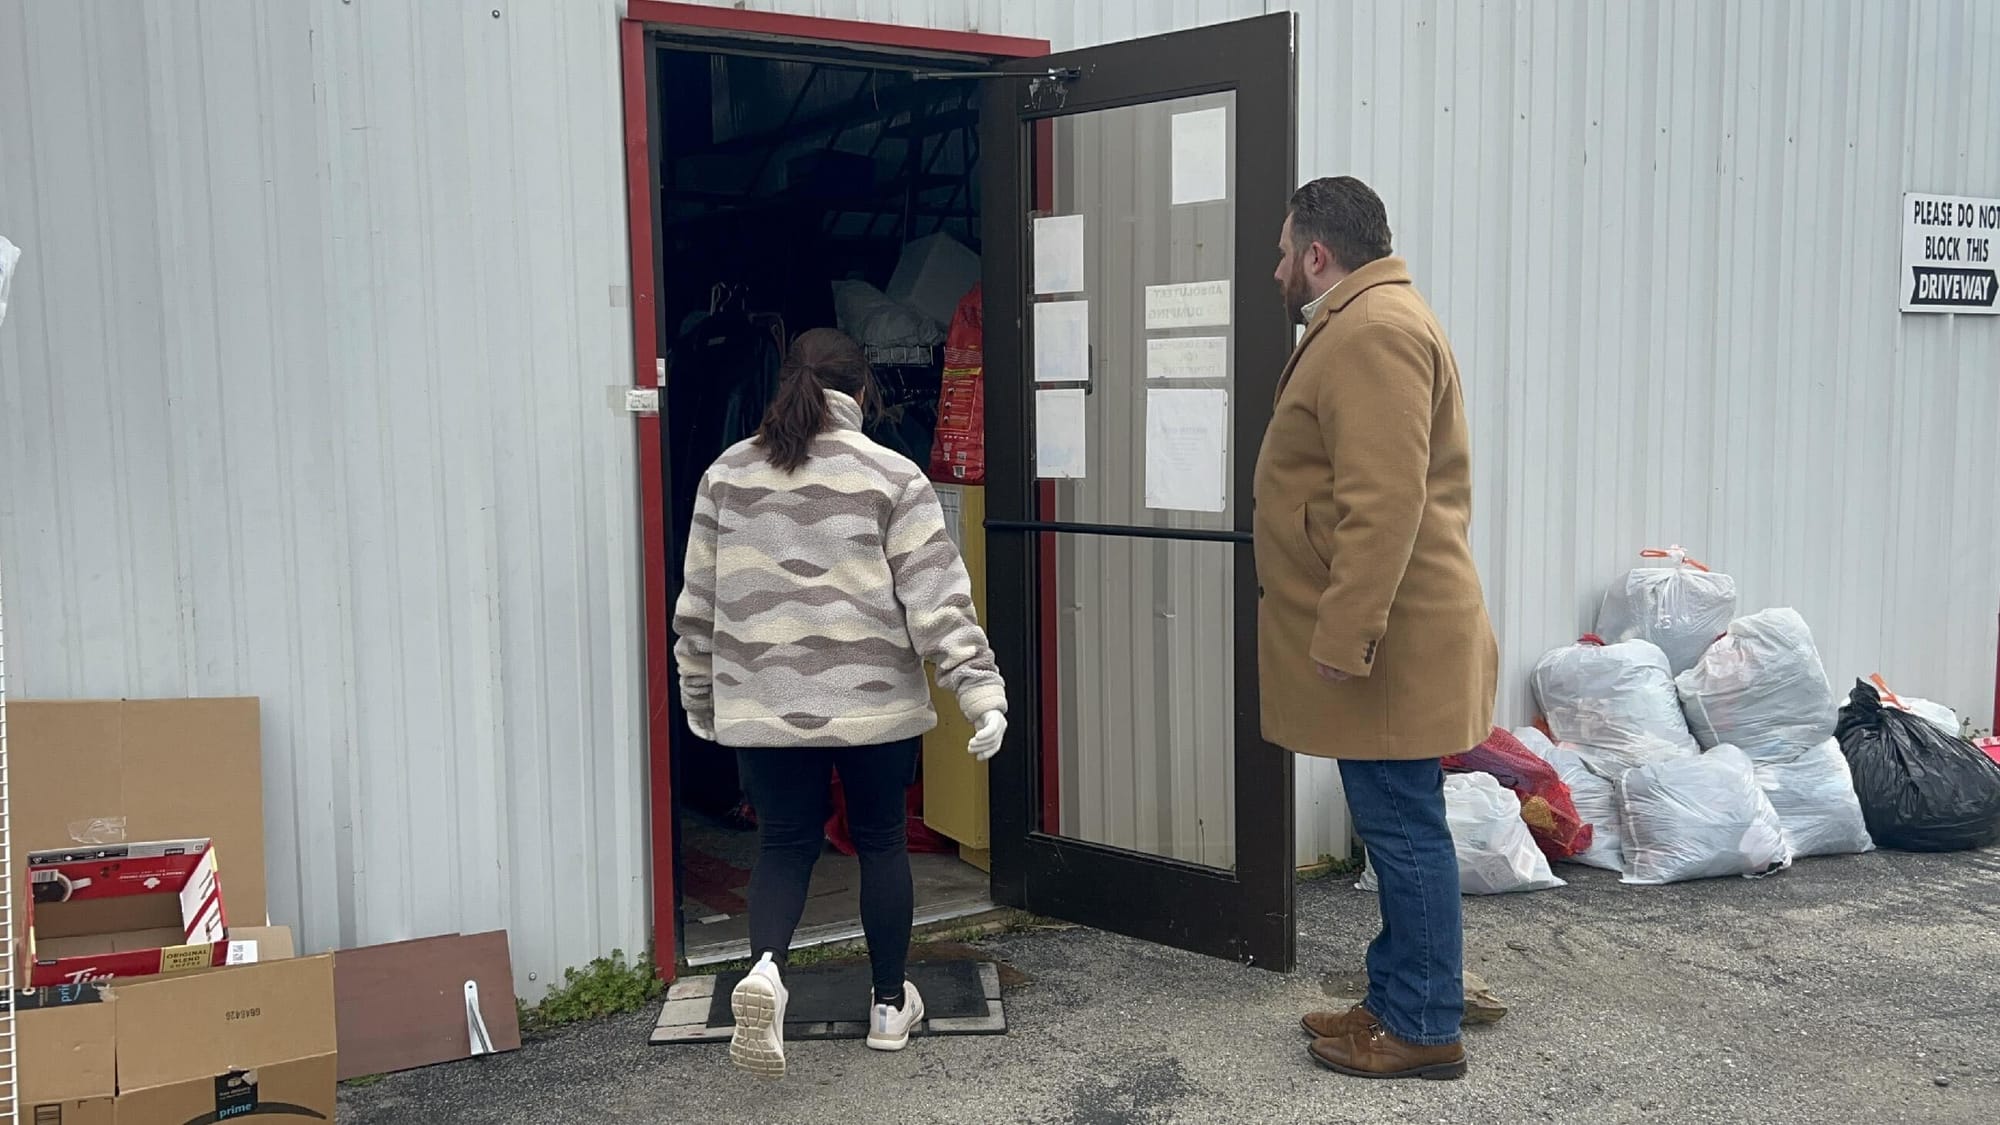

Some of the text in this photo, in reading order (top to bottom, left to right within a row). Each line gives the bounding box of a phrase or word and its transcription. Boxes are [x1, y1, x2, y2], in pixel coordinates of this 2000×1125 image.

[1914, 201, 2000, 229] PLEASE DO NOT
[1925, 236, 1989, 262] BLOCK THIS
[1918, 274, 1991, 300] DRIVEWAY
[167, 949, 207, 959] ORIGINAL
[219, 1103, 252, 1119] prime
